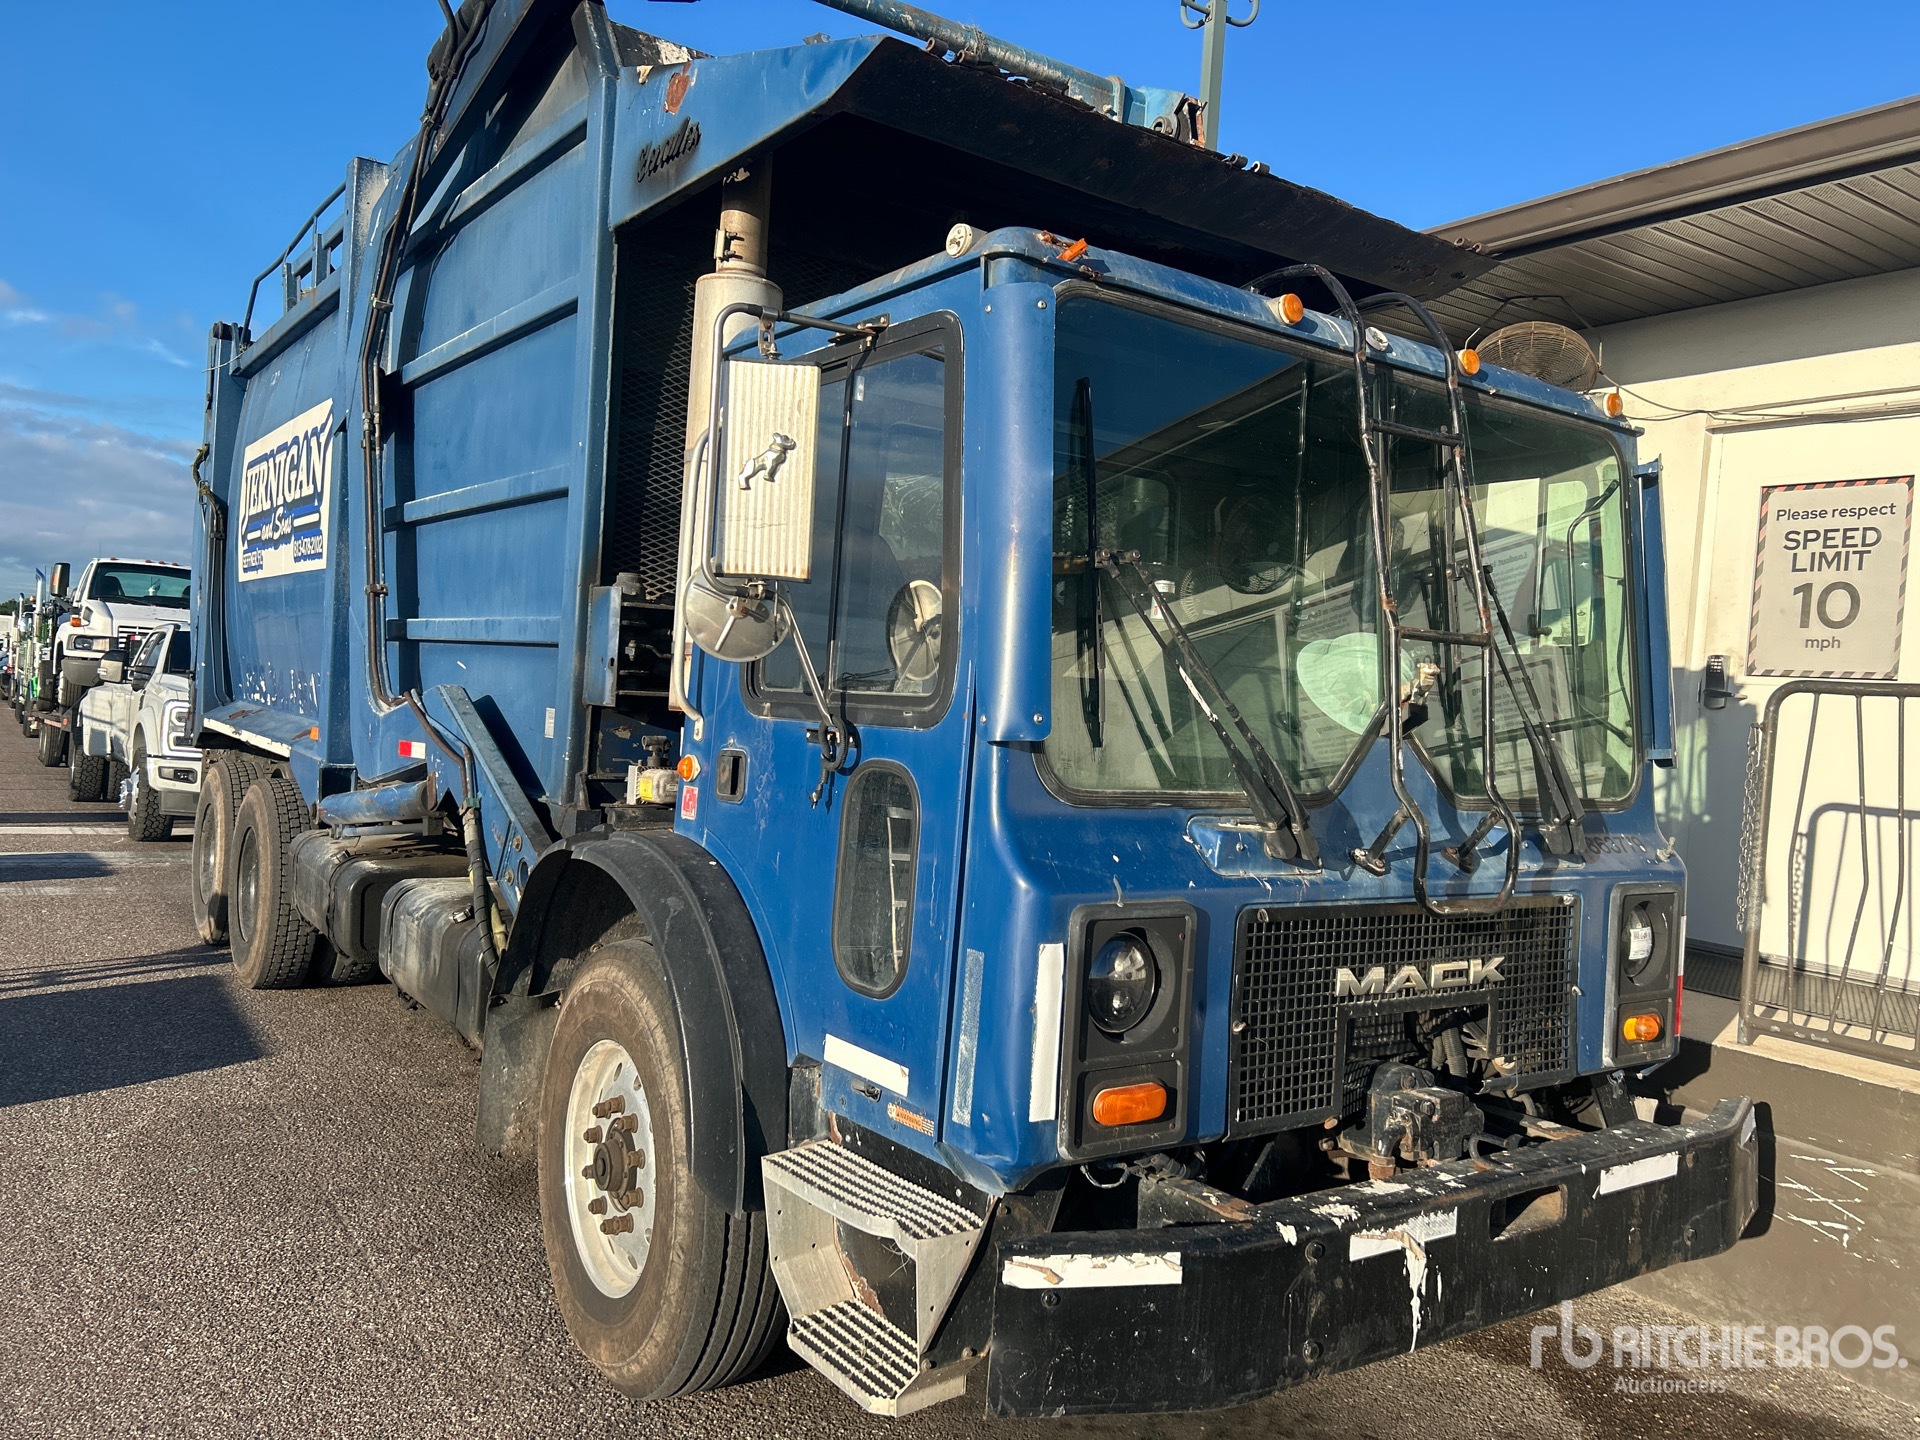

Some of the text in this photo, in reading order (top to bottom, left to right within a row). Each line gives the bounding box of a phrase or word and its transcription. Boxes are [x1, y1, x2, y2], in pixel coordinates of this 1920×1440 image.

[242, 413, 333, 534] JERNIGAN
[1775, 502, 1896, 521] Please respect
[261, 512, 274, 541] and
[1783, 526, 1882, 550] SPEED
[1791, 550, 1871, 573] LIMIT
[1792, 581, 1861, 629] 10
[1805, 636, 1841, 651] mph
[1335, 956, 1505, 996] MACK
